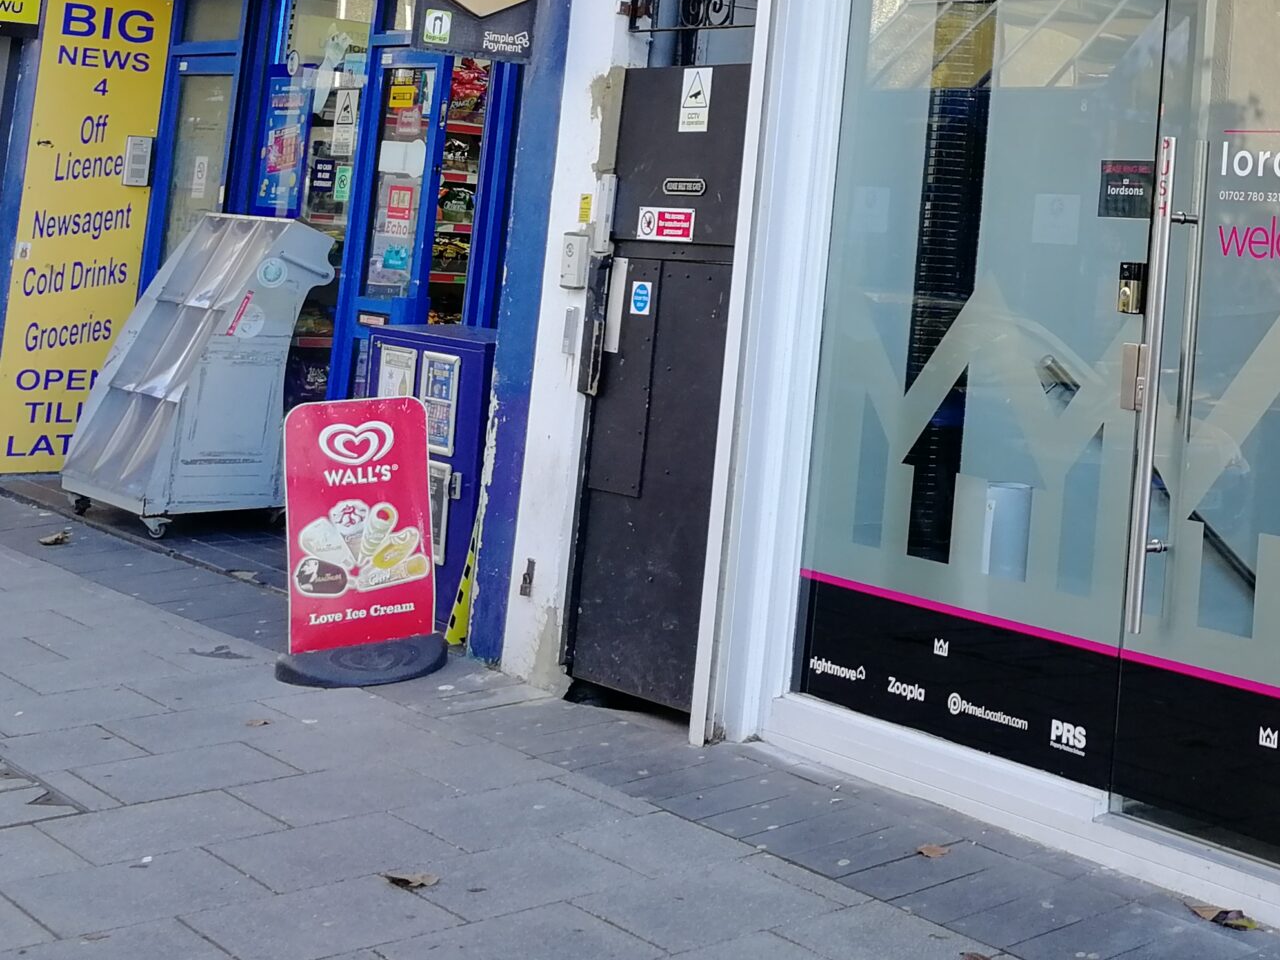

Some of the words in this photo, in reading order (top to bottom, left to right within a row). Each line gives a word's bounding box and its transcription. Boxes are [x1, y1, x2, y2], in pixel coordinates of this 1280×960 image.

[61, 2, 155, 43] BIG
[482, 40, 523, 53] Payment
[484, 31, 515, 44] Simple
[57, 45, 151, 72] NEWS
[94, 78, 109, 96] 4
[80, 115, 109, 144] Off
[54, 152, 123, 181] Licence
[1107, 184, 1144, 196] lordsons
[1219, 190, 1245, 202] 01702
[1247, 191, 1265, 202] 780
[32, 201, 132, 240] Newsagent
[23, 264, 64, 297] Cold
[70, 257, 128, 290] Drinks
[25, 314, 112, 352] Groceries
[6, 434, 74, 457] LAT
[323, 464, 393, 487] WALL'S
[309, 612, 343, 626] Love
[345, 608, 367, 620] Ice
[369, 602, 415, 617] Cream
[809, 656, 857, 681] rightmove
[887, 676, 926, 702] Zoopla
[961, 698, 1029, 730] PrimeLocation.com
[1050, 718, 1087, 749] PRS
